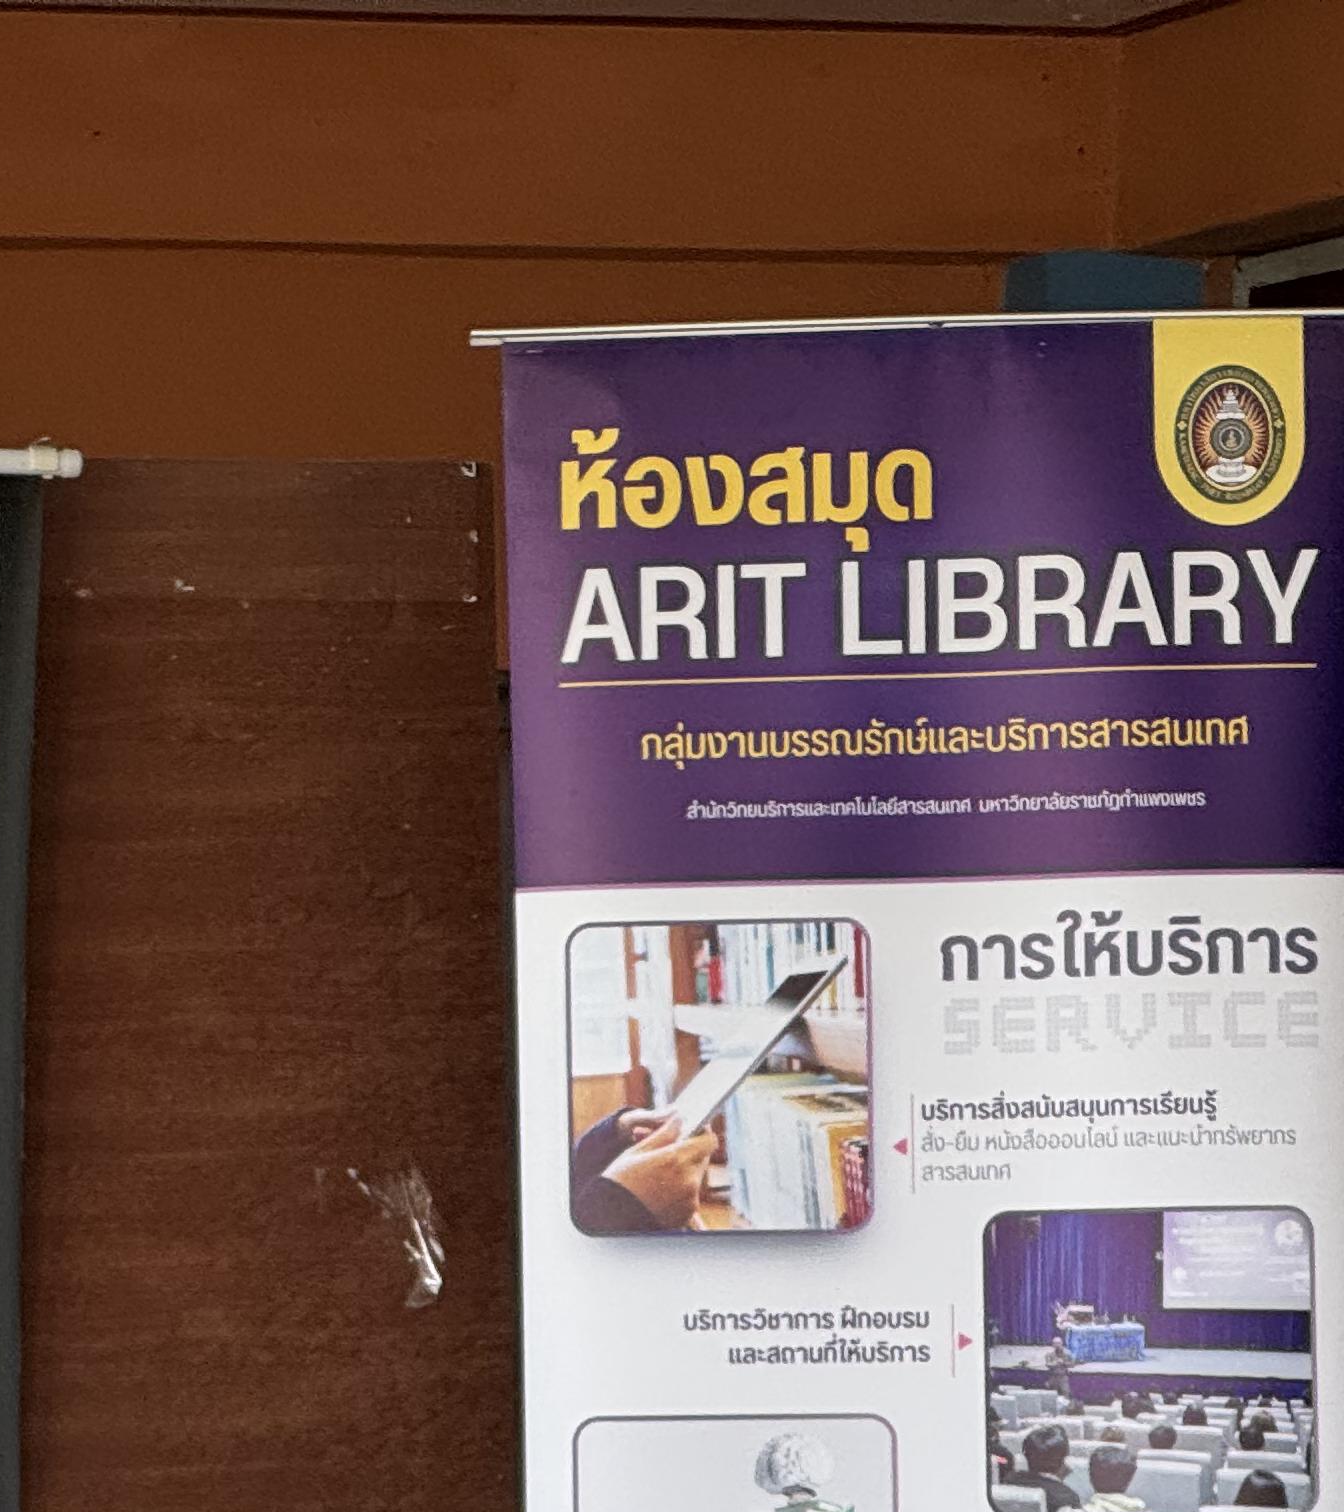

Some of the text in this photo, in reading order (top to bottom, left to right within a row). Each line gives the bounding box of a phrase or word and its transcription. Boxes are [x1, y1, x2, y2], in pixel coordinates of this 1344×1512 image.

[560, 428, 934, 552] ห้องสมุด
[560, 548, 1318, 664] ARIT LIBRARY
[641, 713, 1249, 771] กลุ่มงานบรรณรักษ์และบริการสารสนเทศ
[686, 789, 1207, 819] สำนักวิทยบริการและเทคโนโลยีสารสนเทศ มหาวิทยาลัยราชภัฏกำแพงเพชร
[940, 910, 1318, 981] การให้บริการ
[943, 991, 1318, 1055] SERVICE
[921, 1089, 1218, 1123] บริการสิ่งสนับสนุนการเรียนรู้
[922, 1161, 1012, 1182] สารสนเทศ
[683, 1304, 930, 1331] บริการวิชาการ ฝึกอบรม
[728, 1333, 931, 1365] และสถานที่ให้บริการ
